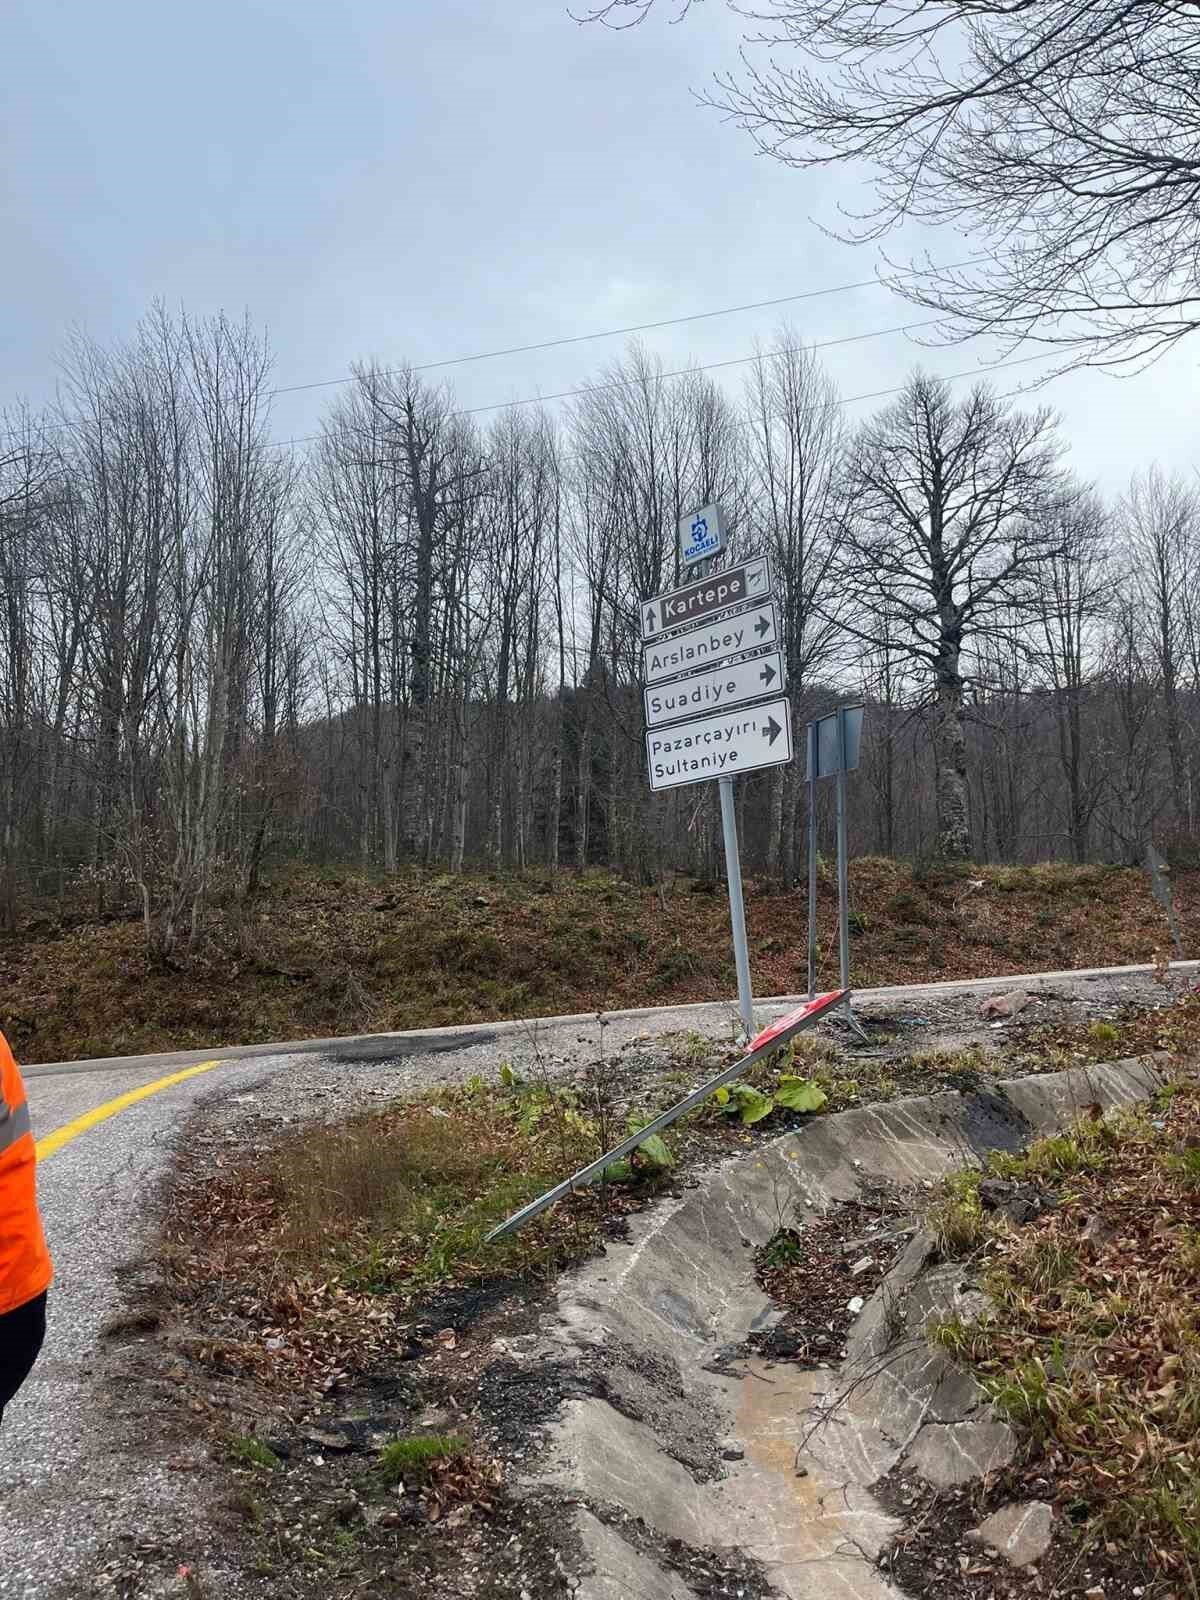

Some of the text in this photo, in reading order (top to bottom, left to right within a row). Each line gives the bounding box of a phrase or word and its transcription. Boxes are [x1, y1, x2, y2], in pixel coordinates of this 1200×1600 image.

[664, 579, 741, 619] Kartepe
[650, 630, 744, 672] Arslanbey
[651, 681, 737, 713] Suadiye
[652, 721, 756, 756] Pazarçayırı
[655, 750, 738, 778] Sultaniye
